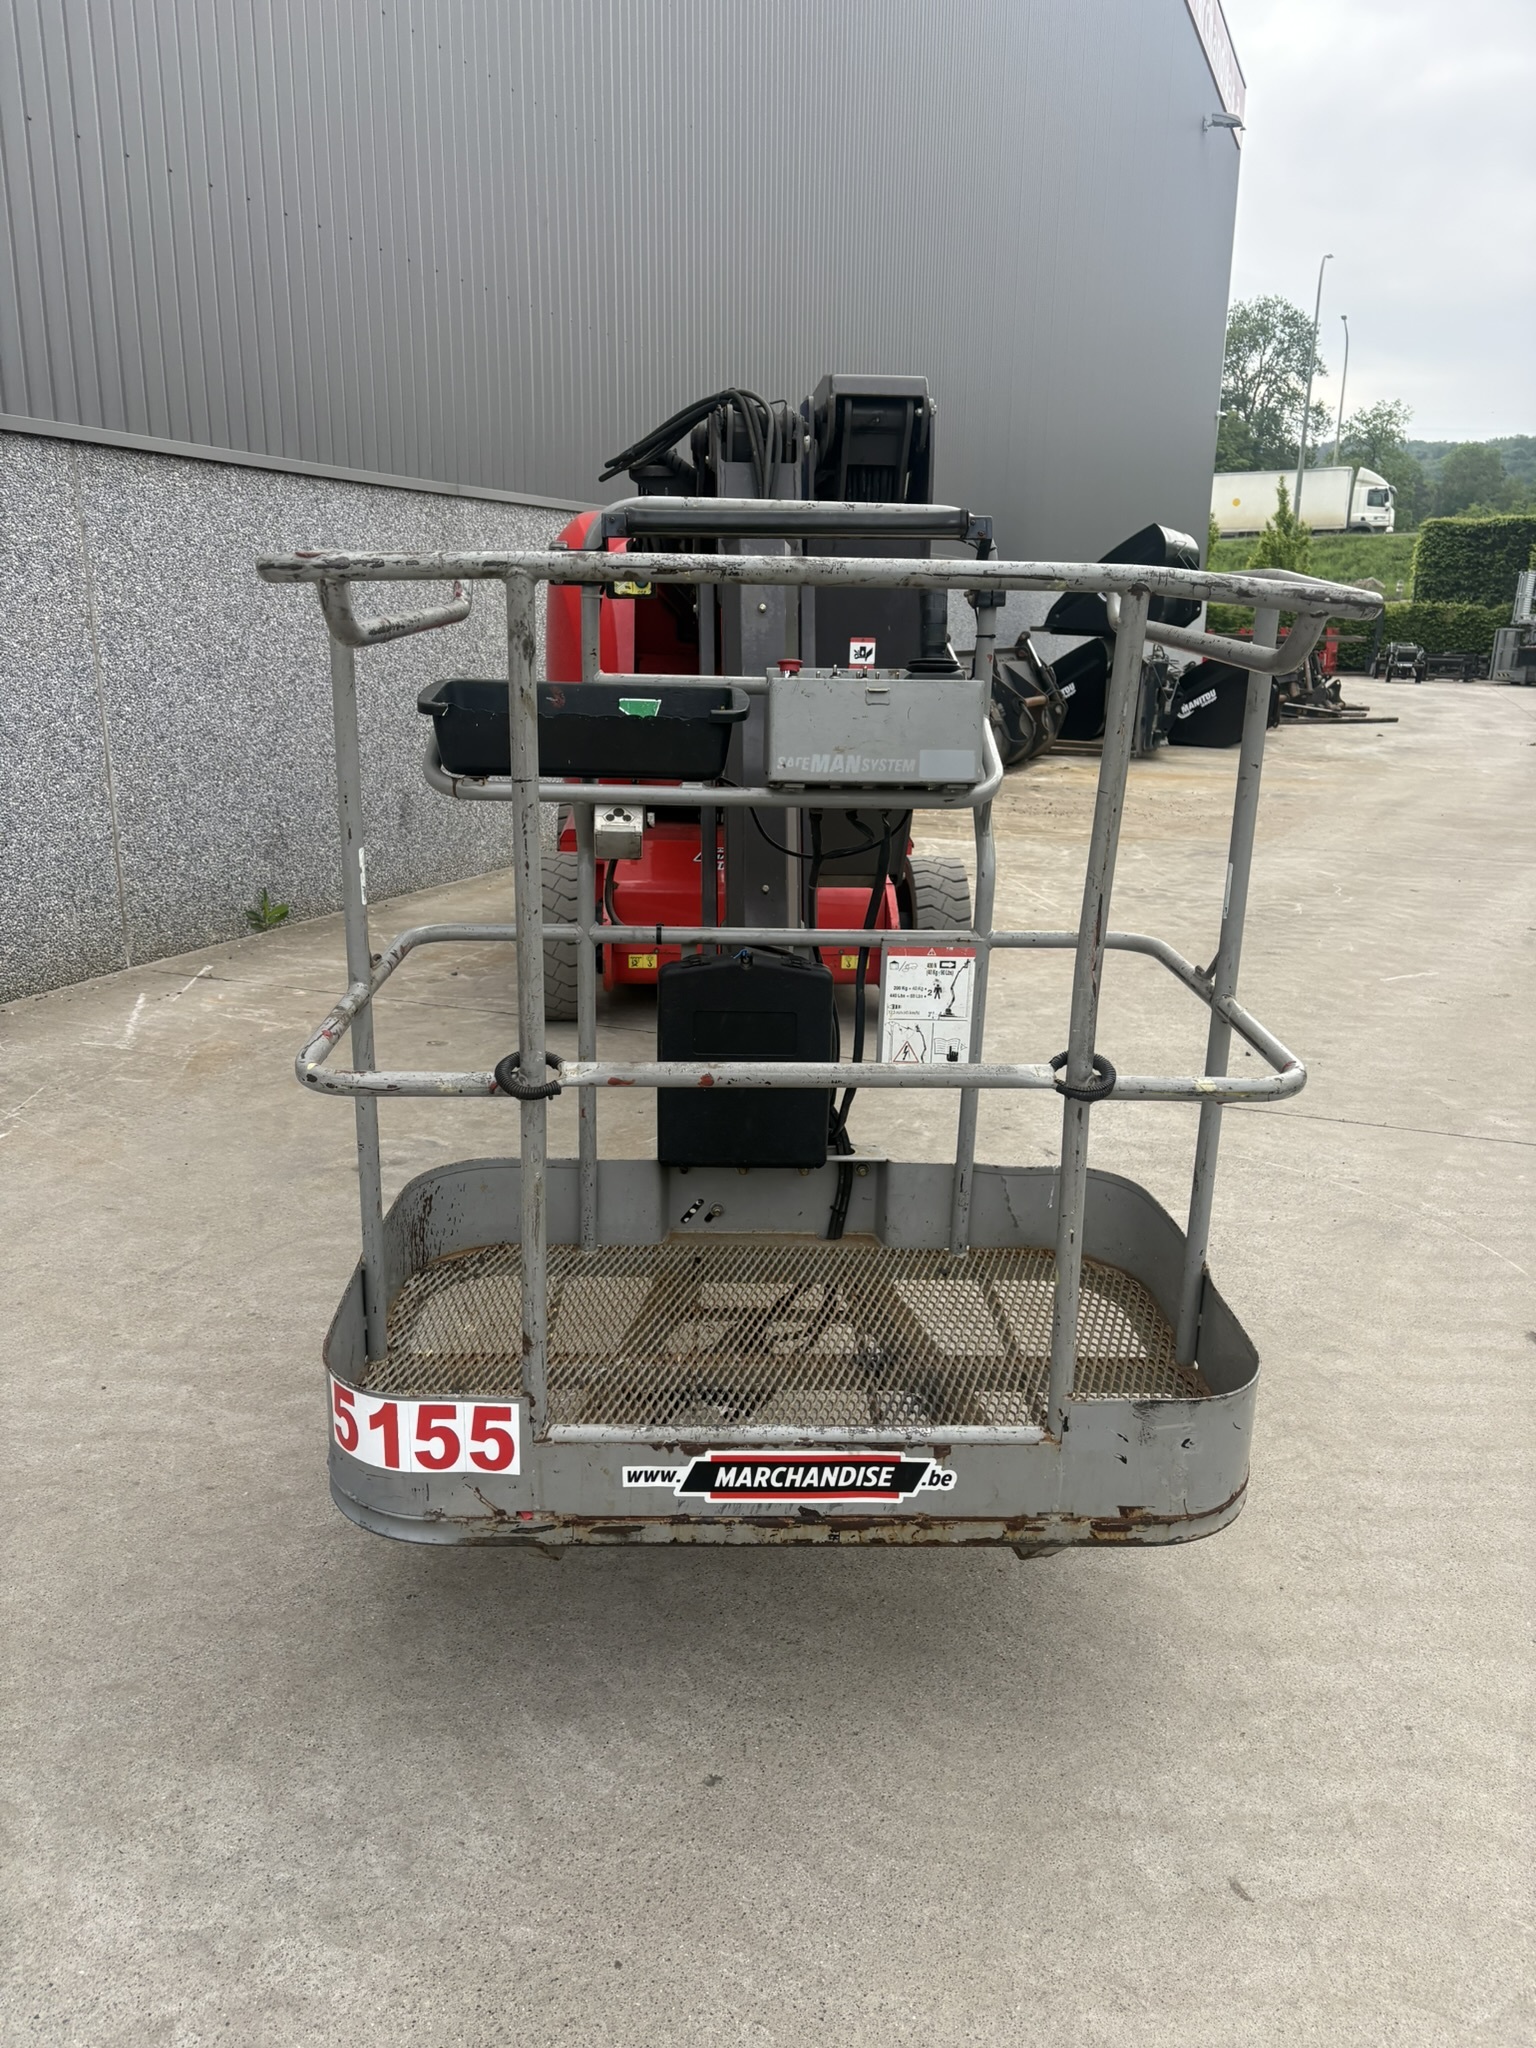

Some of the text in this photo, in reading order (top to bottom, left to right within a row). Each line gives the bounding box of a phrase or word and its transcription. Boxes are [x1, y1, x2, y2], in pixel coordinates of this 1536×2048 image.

[1180, 689, 1217, 714] MANITOU
[334, 1383, 515, 1471] 5155
[626, 1466, 953, 1488] www. MARCHANDISE .be
